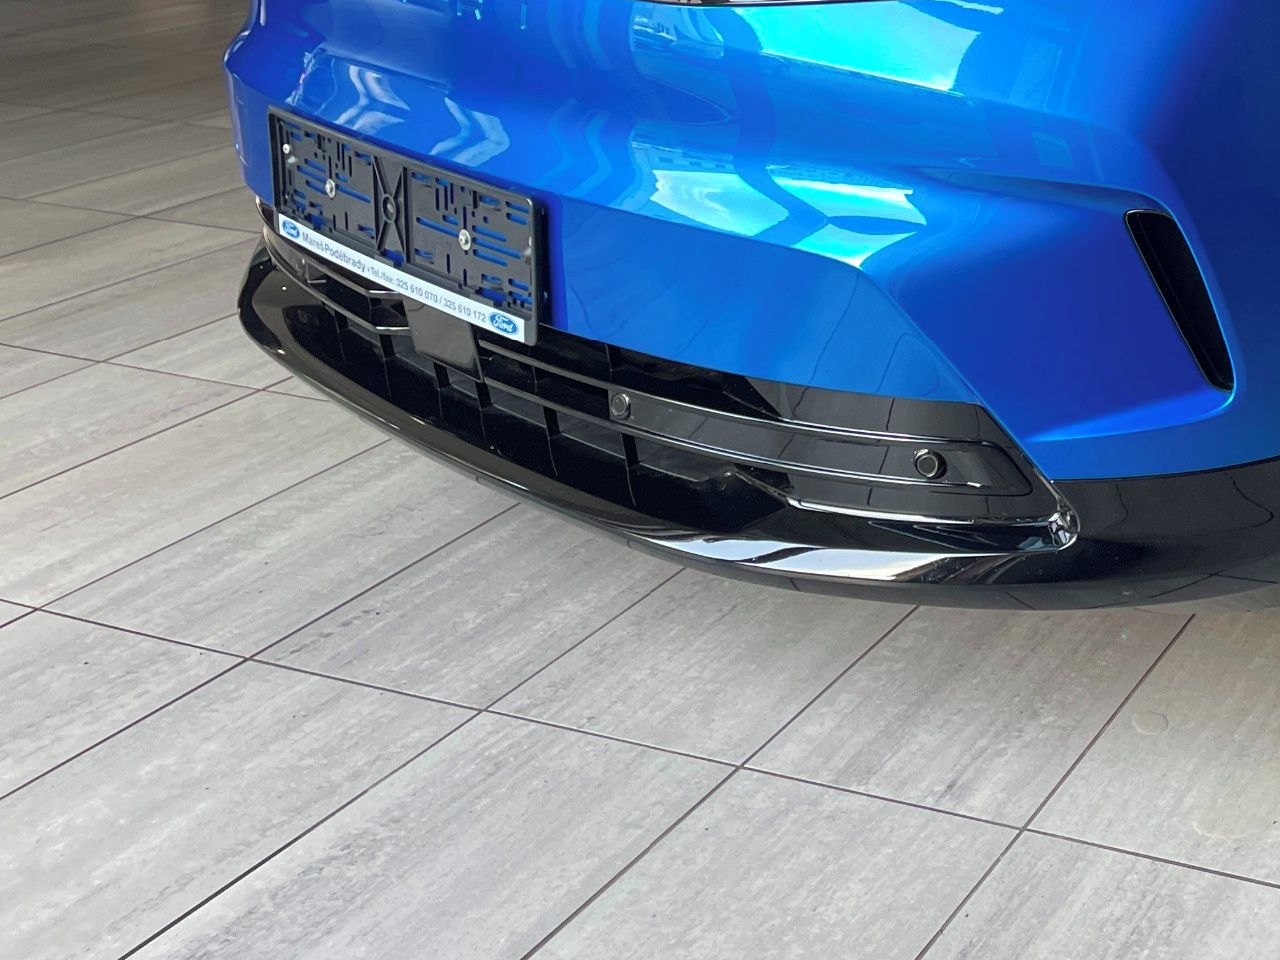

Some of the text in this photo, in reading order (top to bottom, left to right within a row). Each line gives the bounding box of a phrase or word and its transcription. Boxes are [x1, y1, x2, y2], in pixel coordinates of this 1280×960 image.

[396, 278, 409, 291] 325
[410, 284, 423, 297] 610
[424, 290, 438, 303] 070
[443, 297, 457, 311] 325
[458, 304, 471, 317] 610
[473, 310, 487, 323] 172
[493, 313, 514, 332] Ford
